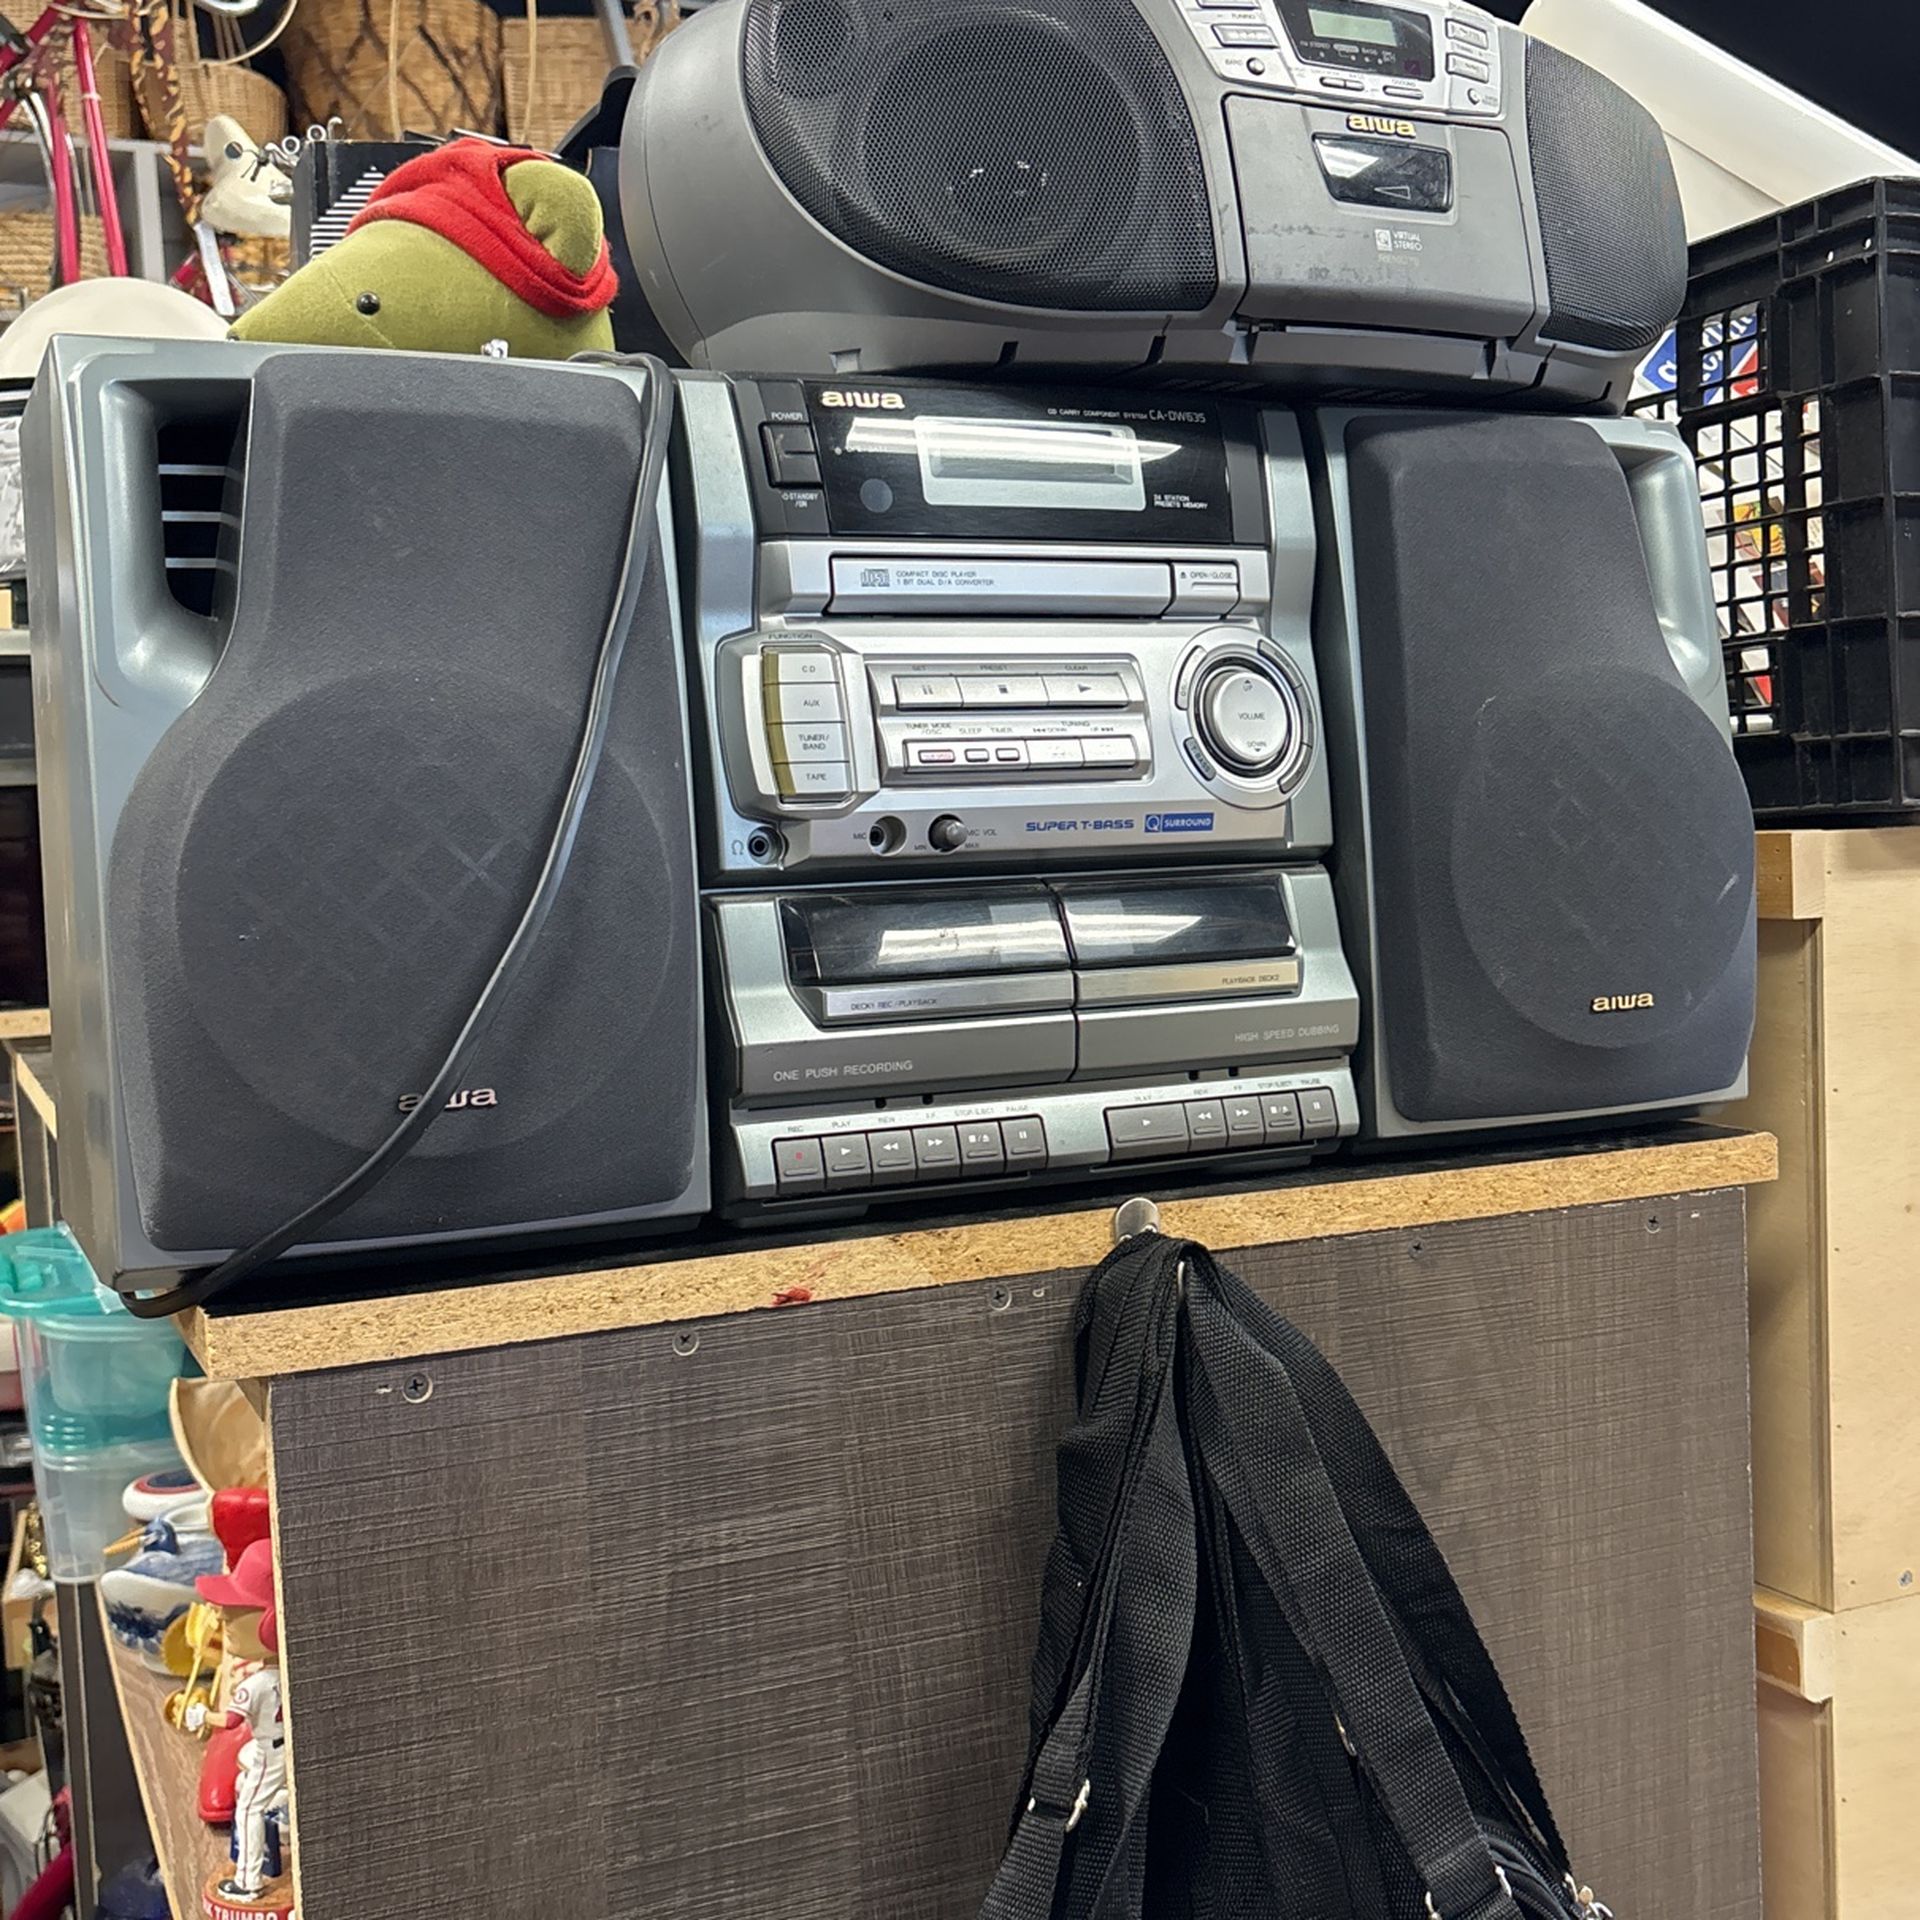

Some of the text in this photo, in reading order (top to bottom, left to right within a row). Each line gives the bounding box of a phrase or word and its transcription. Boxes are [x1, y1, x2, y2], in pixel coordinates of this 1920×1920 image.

[1347, 113, 1417, 138] aiwa
[1393, 240, 1423, 251] STEREO
[821, 390, 905, 409] aiwa
[771, 412, 803, 421] POWER
[1059, 408, 1081, 417] CARRY
[1149, 410, 1206, 423] CA-DW635
[789, 493, 818, 501] STANDBY
[768, 633, 813, 641] FUNCTION
[802, 665, 816, 673] CD
[803, 699, 820, 707] AUX
[1238, 712, 1266, 721] VOLUME
[1026, 819, 1134, 832] SUPER T-BASS
[1163, 817, 1212, 828] SURROUND
[1591, 992, 1655, 1012] aiwa
[1234, 1023, 1339, 1042] HIGH SPEED DUBBING
[773, 1060, 913, 1083] ONE PUSH RECORDING
[398, 1088, 498, 1111] awa
[787, 1125, 804, 1133] REC
[832, 1121, 852, 1129] PLAY
